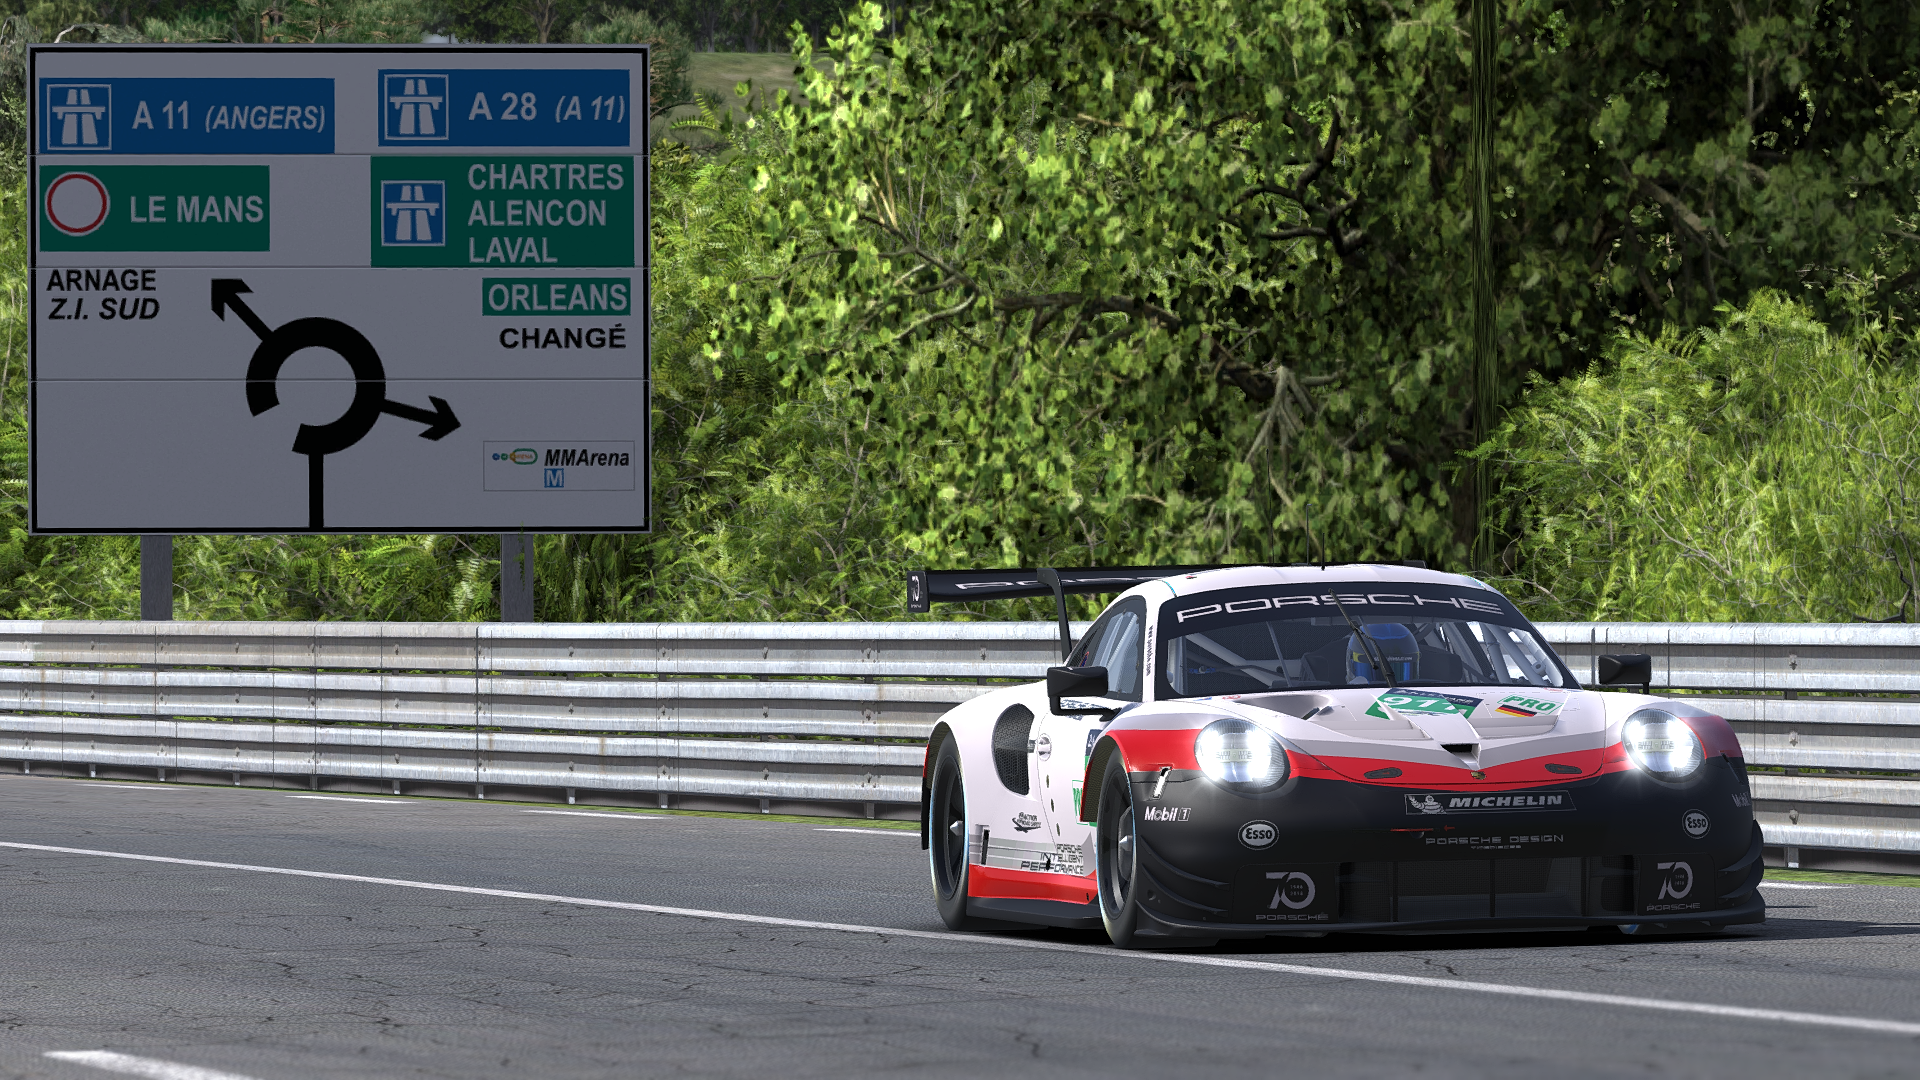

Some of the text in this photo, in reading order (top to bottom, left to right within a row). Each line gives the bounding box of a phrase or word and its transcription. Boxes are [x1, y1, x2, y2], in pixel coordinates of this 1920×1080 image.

[132, 100, 189, 129] A 11
[205, 105, 325, 133] (ANGERS)
[468, 92, 538, 120] A 28
[555, 96, 626, 123] (A 11)
[468, 163, 625, 190] CHARTRES
[130, 195, 264, 223] LE MANS
[468, 200, 607, 226] ALENCON
[469, 237, 558, 263] LAVAL
[46, 269, 156, 291] ARNAGE
[48, 297, 160, 320] Z.I. SUD
[488, 283, 628, 311] ORLEANS
[499, 323, 627, 349] CHANGÉ
[544, 449, 630, 467] MMArena
[546, 470, 563, 487] M
[1177, 593, 1505, 623] PORSCHE
[1502, 695, 1556, 711] PRO
[1144, 805, 1178, 821] Mobil
[1449, 795, 1563, 808] MICHELIN
[1245, 828, 1272, 839] Esso
[1425, 834, 1565, 846] PORSCHE DESIGN
[1265, 871, 1316, 910] 70
[1657, 861, 1694, 900] 70
[1255, 913, 1329, 921] PORSCHE
[1646, 902, 1701, 912] PORSCHE
